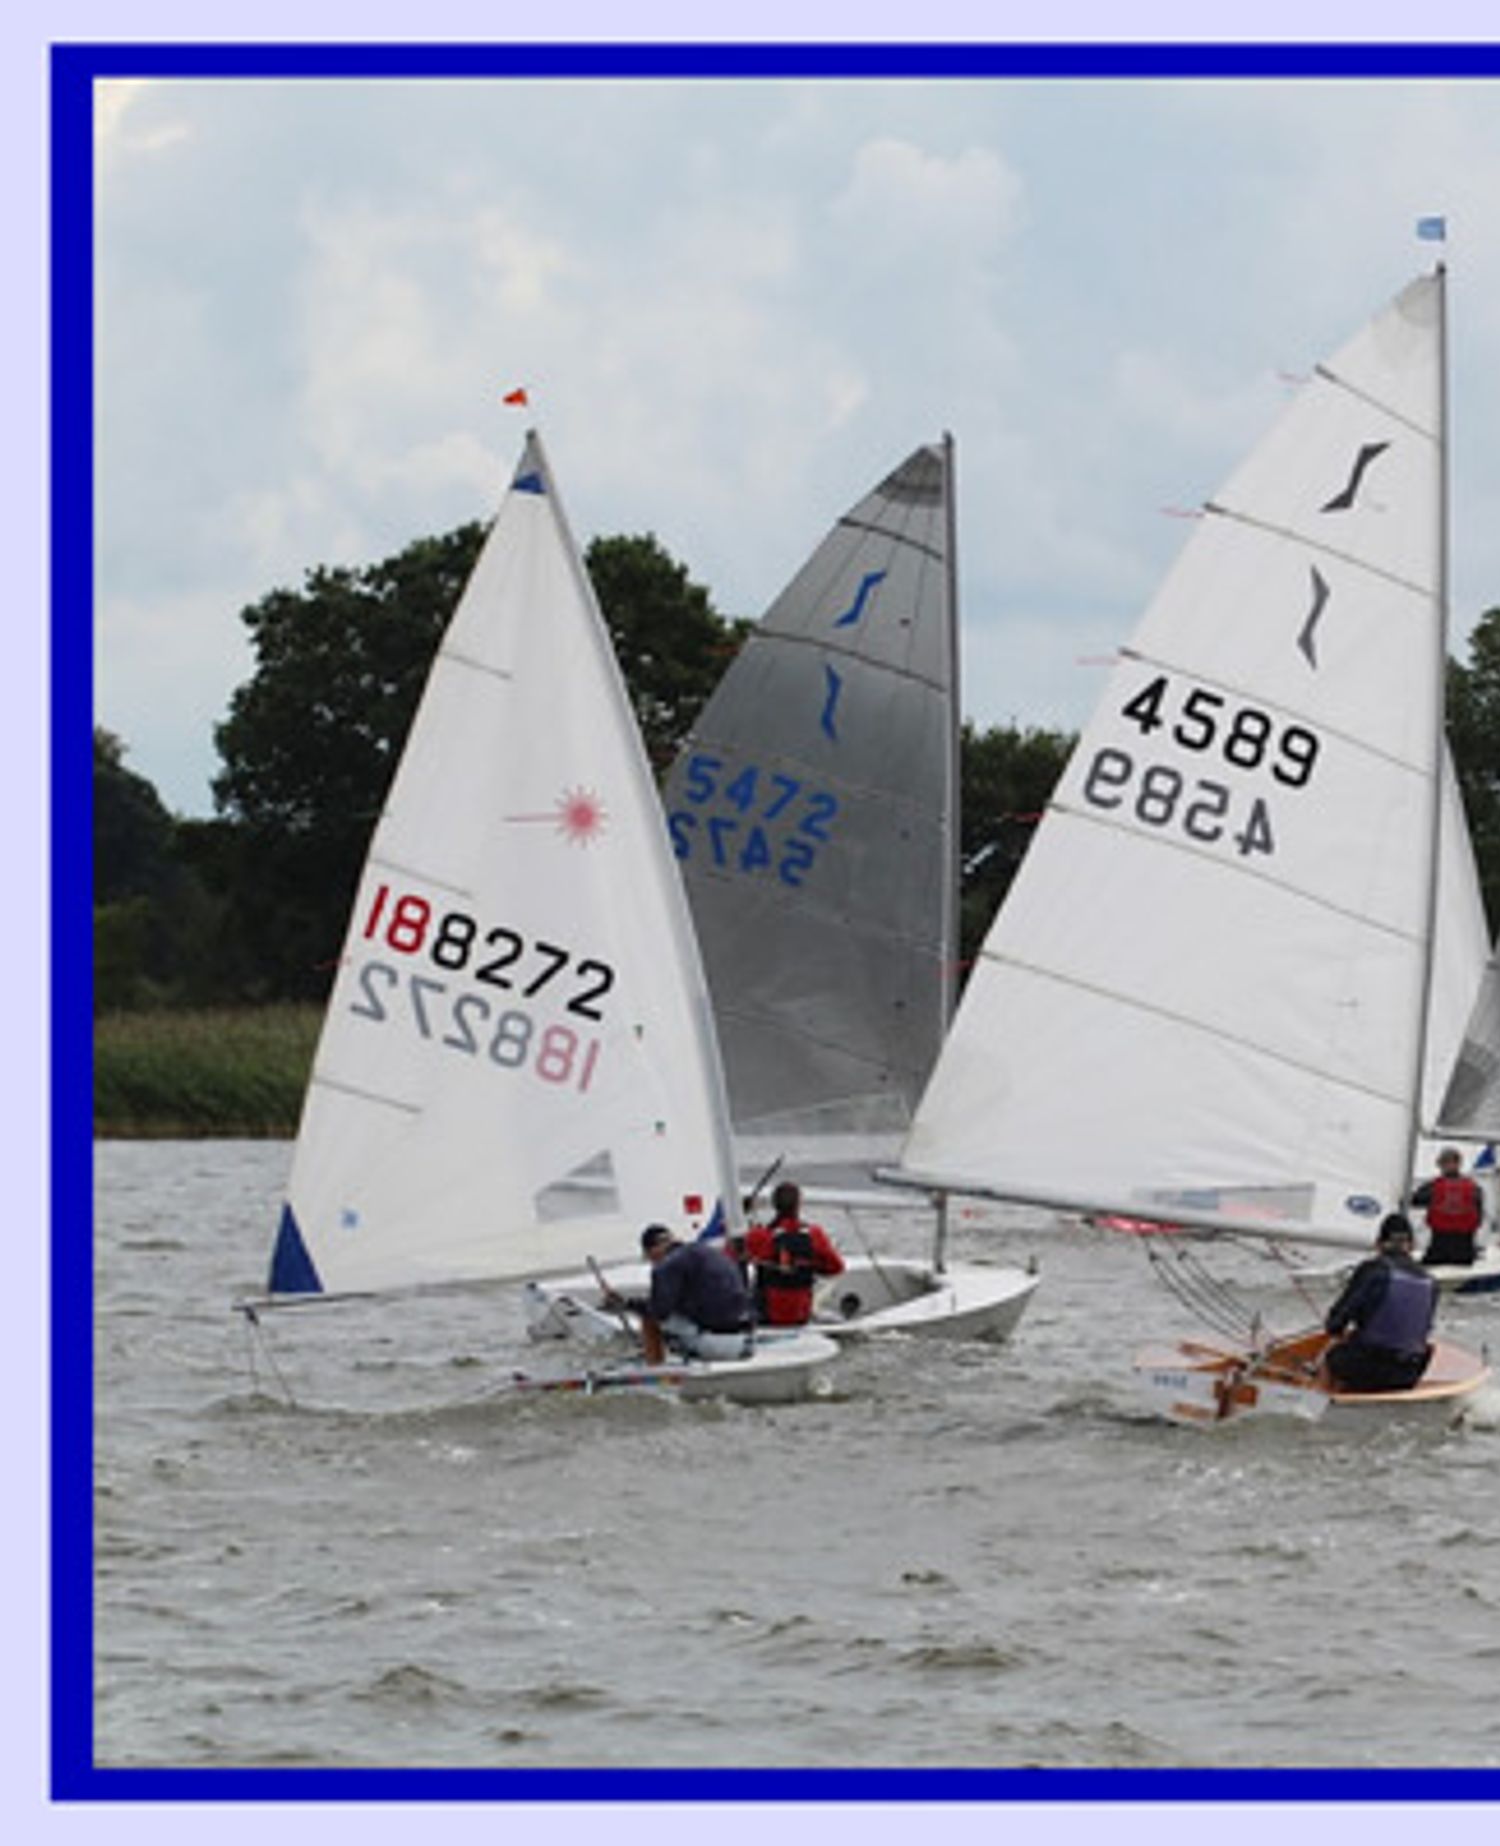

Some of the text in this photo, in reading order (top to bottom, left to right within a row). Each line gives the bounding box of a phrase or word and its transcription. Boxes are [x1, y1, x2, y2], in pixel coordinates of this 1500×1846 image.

[1121, 676, 1320, 789] 4589
[685, 755, 838, 842] 5472
[363, 884, 615, 1021] 188272
